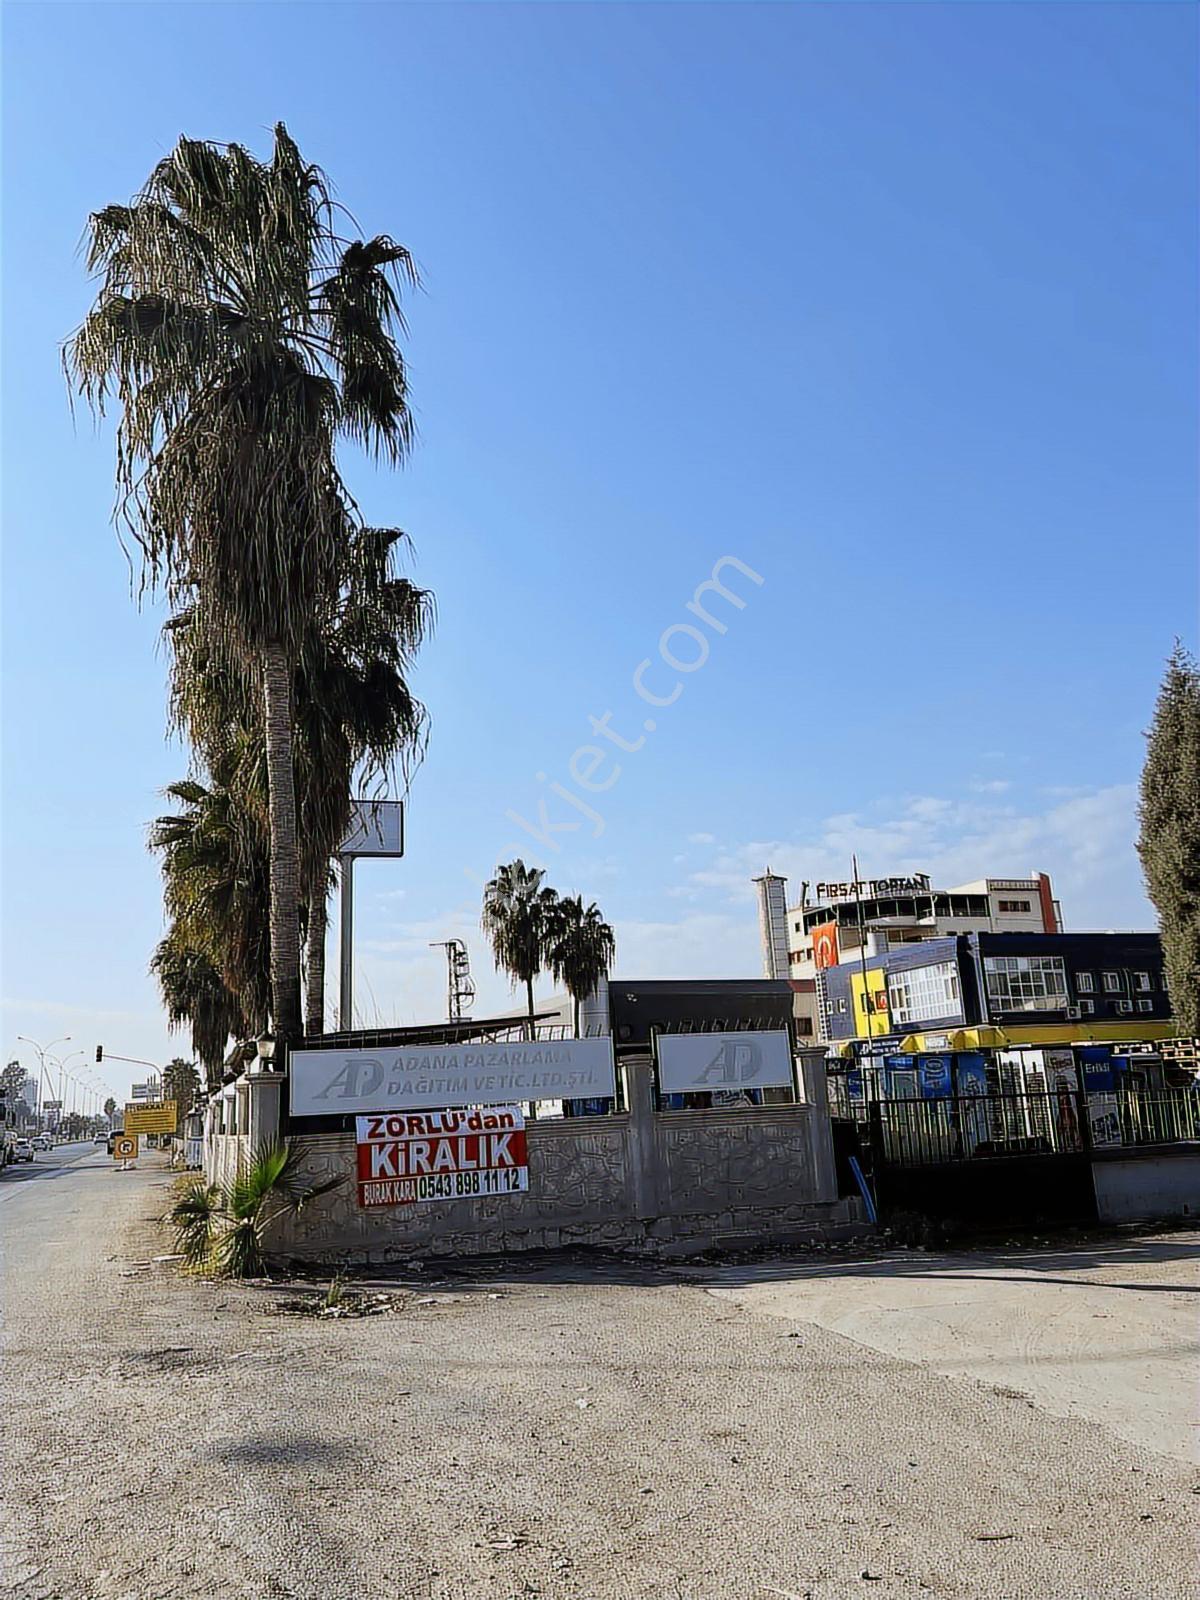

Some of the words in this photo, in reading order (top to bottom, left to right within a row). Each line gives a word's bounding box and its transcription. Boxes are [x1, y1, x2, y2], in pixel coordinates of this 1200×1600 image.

[391, 1054, 459, 1073] ADANA
[386, 1073, 469, 1096] DAĞITIM
[473, 1075, 495, 1091] VE
[367, 1111, 515, 1139] ZORLU'dan
[363, 1182, 392, 1206] BURAK
[393, 1180, 417, 1203] KARA
[419, 1175, 452, 1199] 0543
[456, 1172, 480, 1195] 898
[484, 1171, 499, 1193] 11
[504, 1168, 520, 1191] 12
